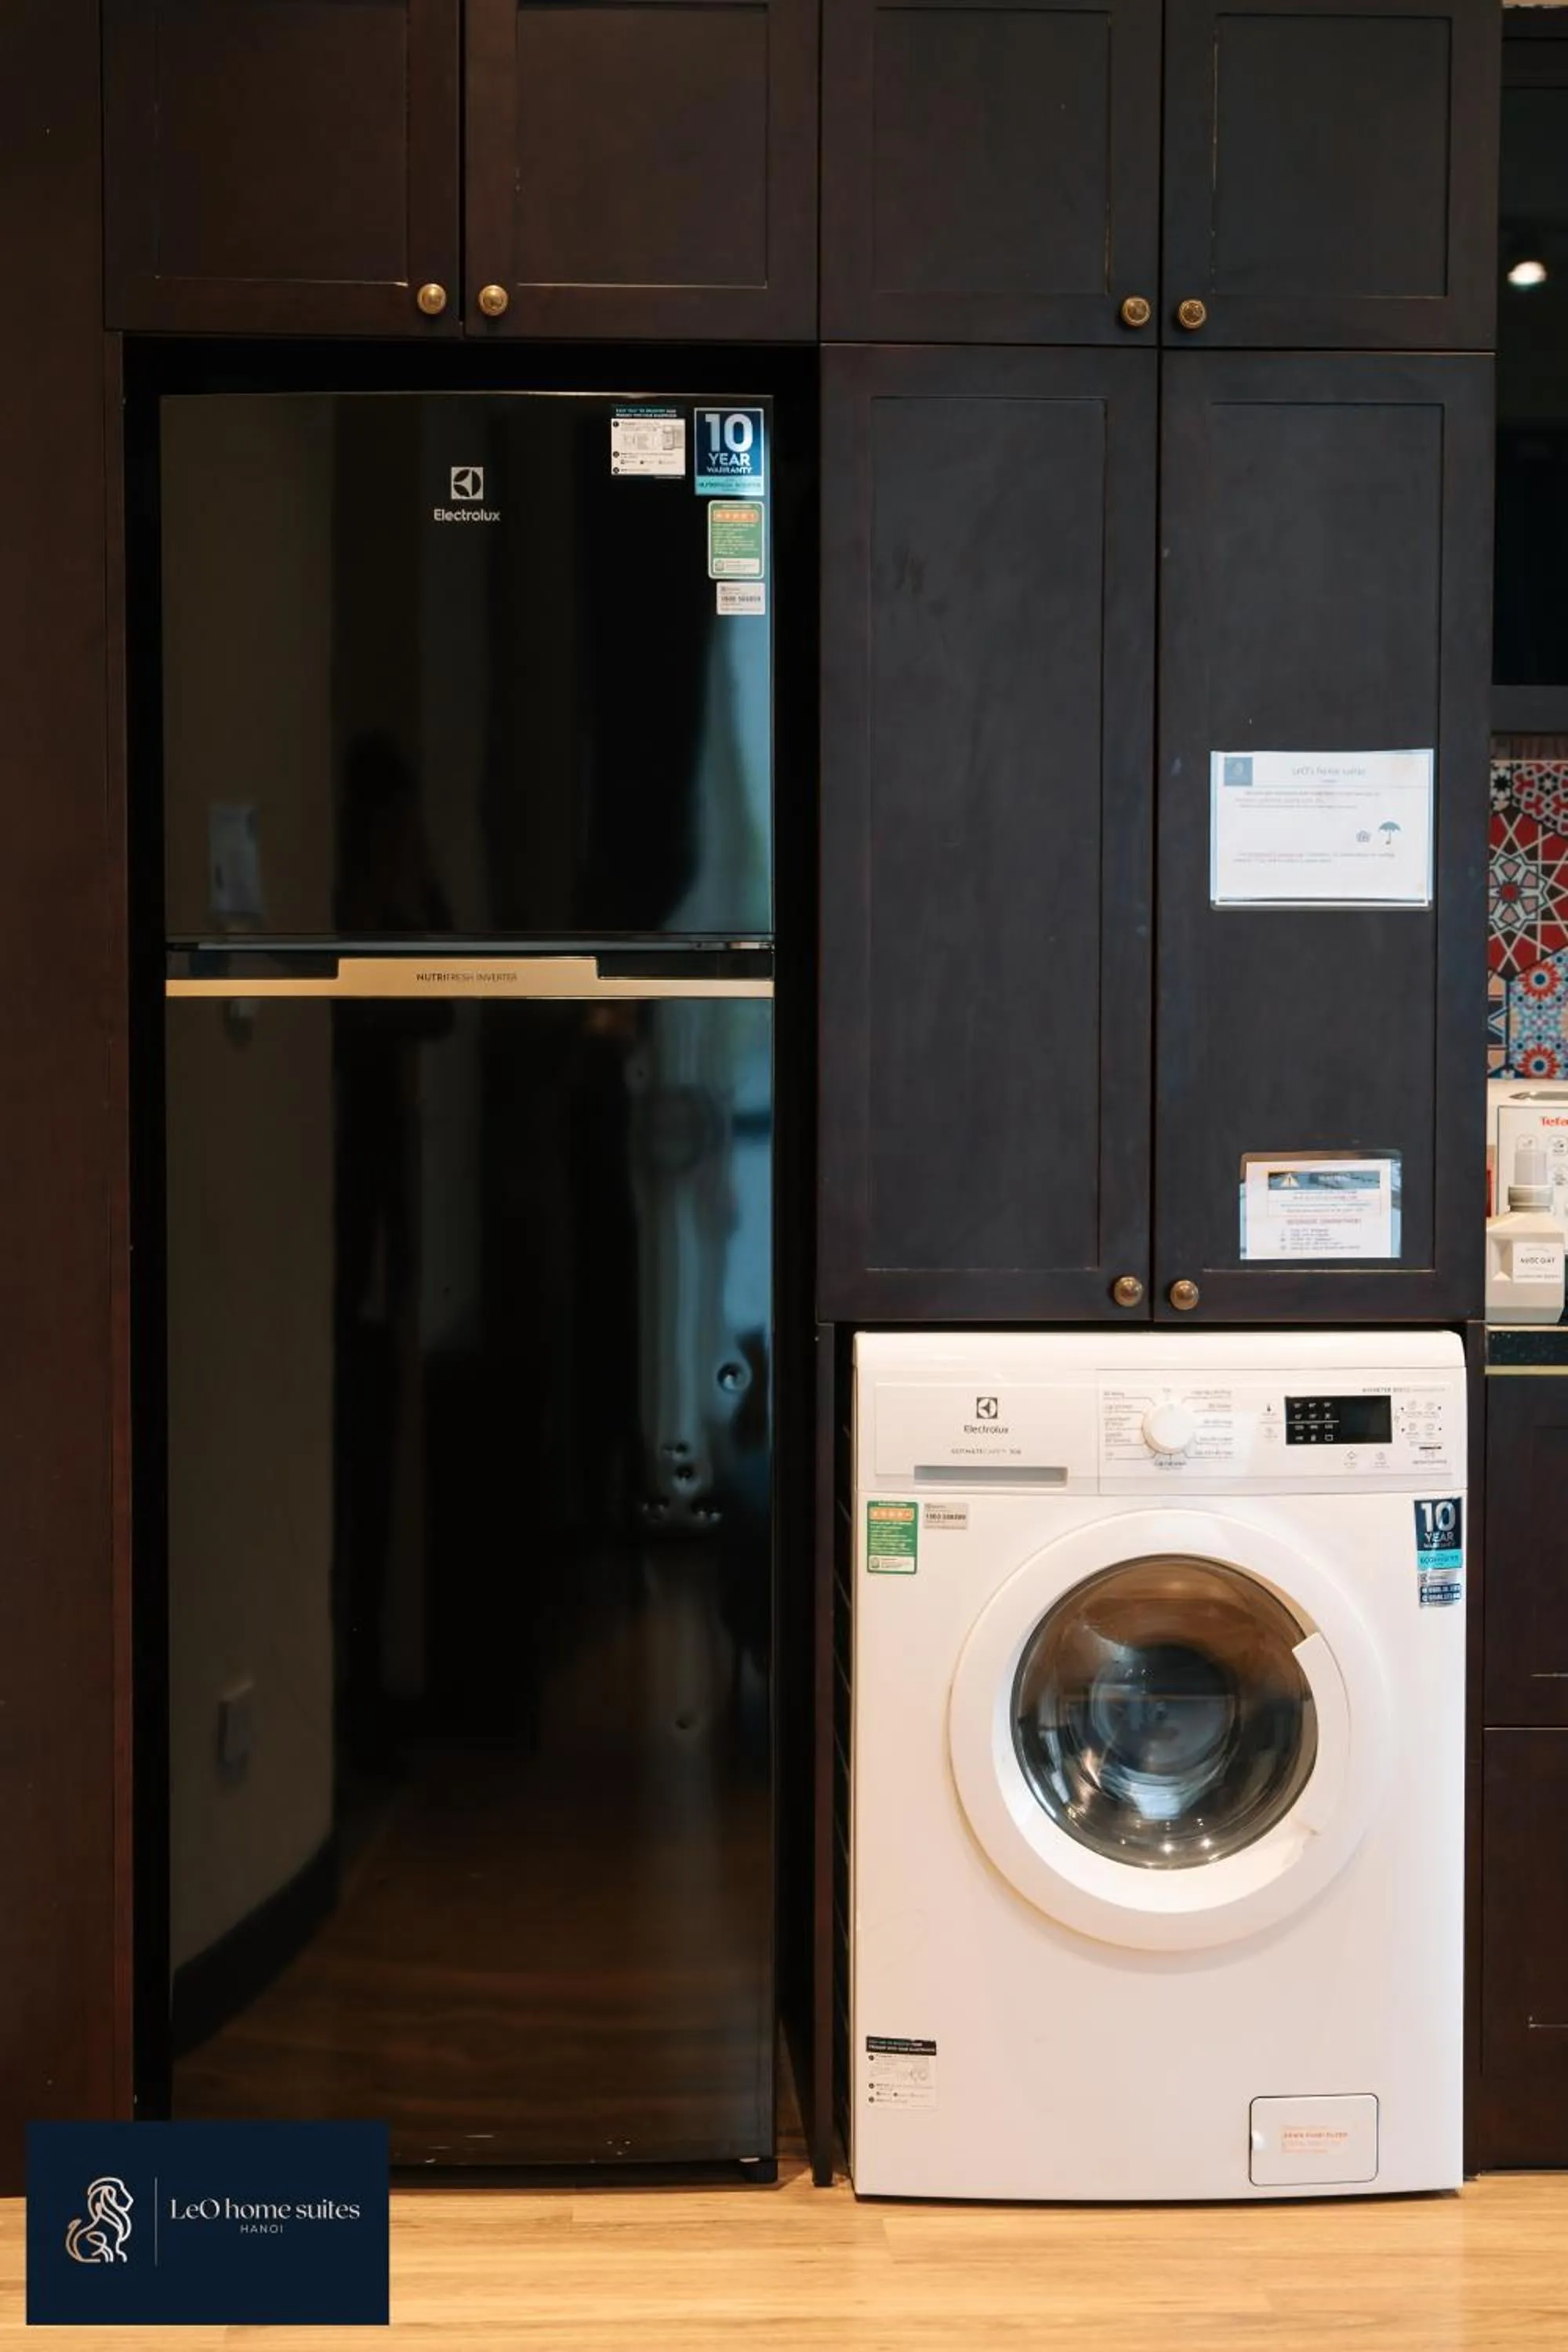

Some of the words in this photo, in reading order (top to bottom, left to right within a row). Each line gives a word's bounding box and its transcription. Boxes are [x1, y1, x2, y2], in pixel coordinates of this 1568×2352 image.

[705, 413, 753, 452] 10
[708, 452, 750, 466] YEAR
[434, 508, 501, 521] Electrolux
[963, 1425, 1009, 1434] Electrolux
[1420, 1501, 1456, 1533] 10
[1425, 1531, 1454, 1543] YEAR
